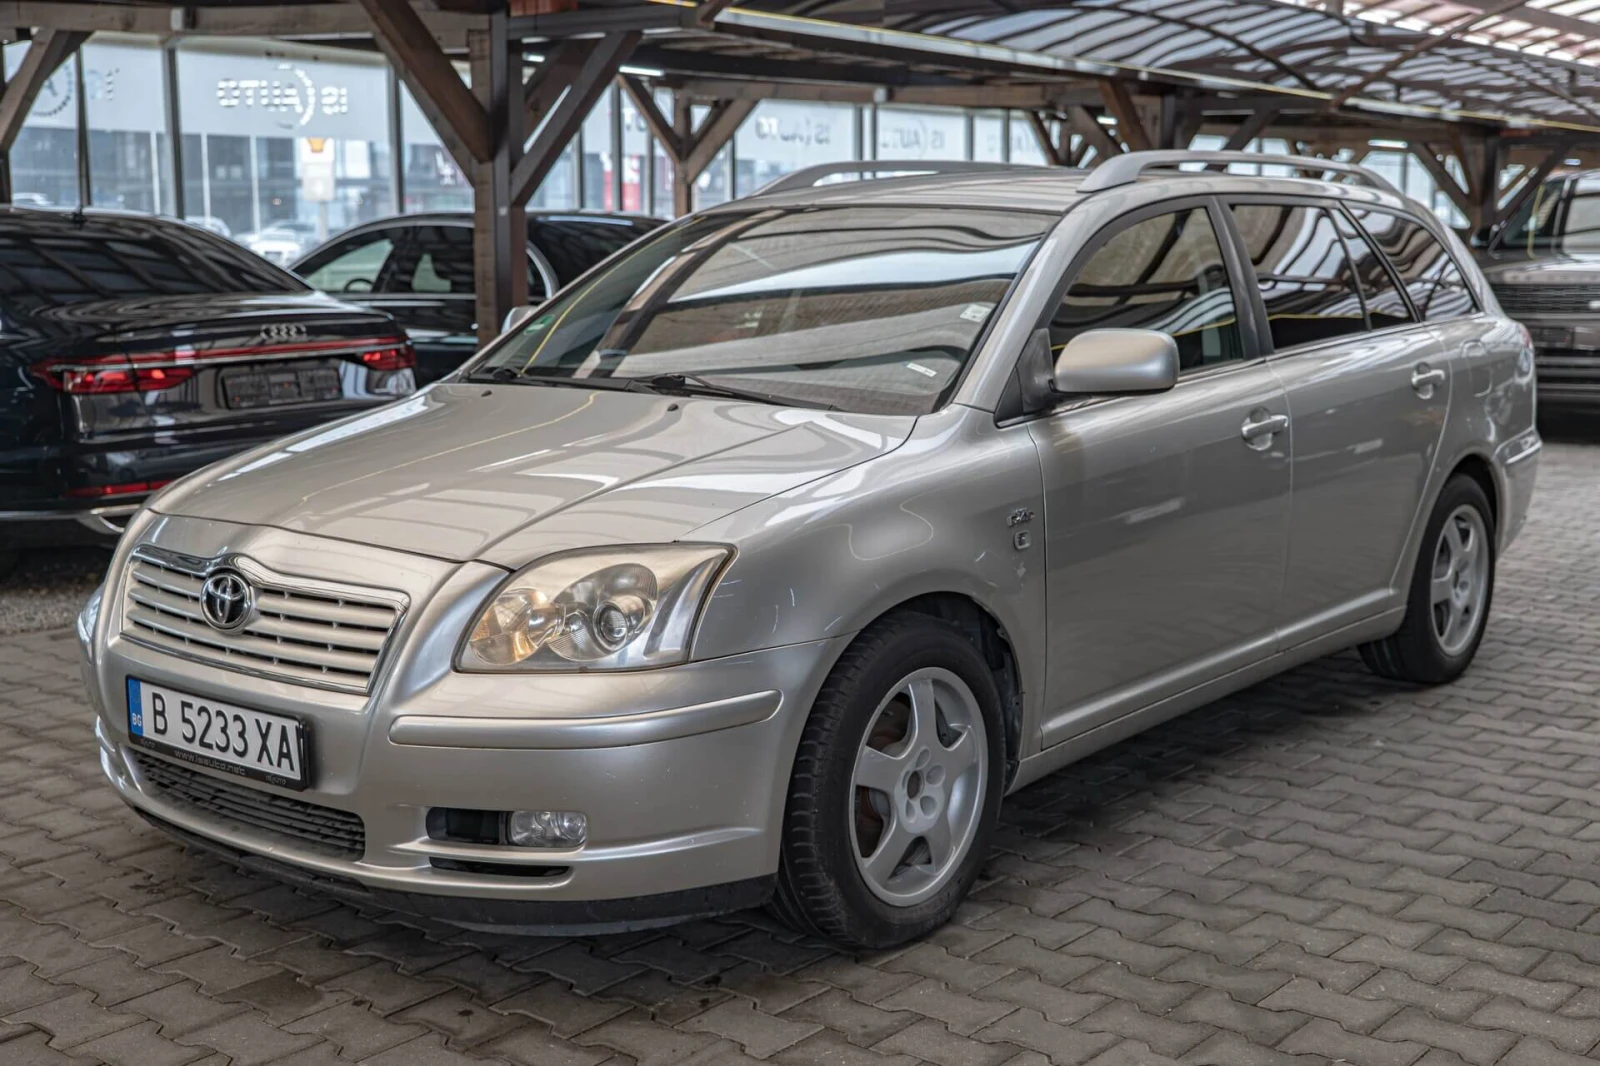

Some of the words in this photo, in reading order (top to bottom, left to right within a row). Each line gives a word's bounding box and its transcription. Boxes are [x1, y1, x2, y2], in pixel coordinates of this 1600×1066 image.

[132, 712, 142, 727] BG
[152, 692, 168, 735] B
[181, 700, 249, 758] 5233
[255, 718, 295, 772] XA
